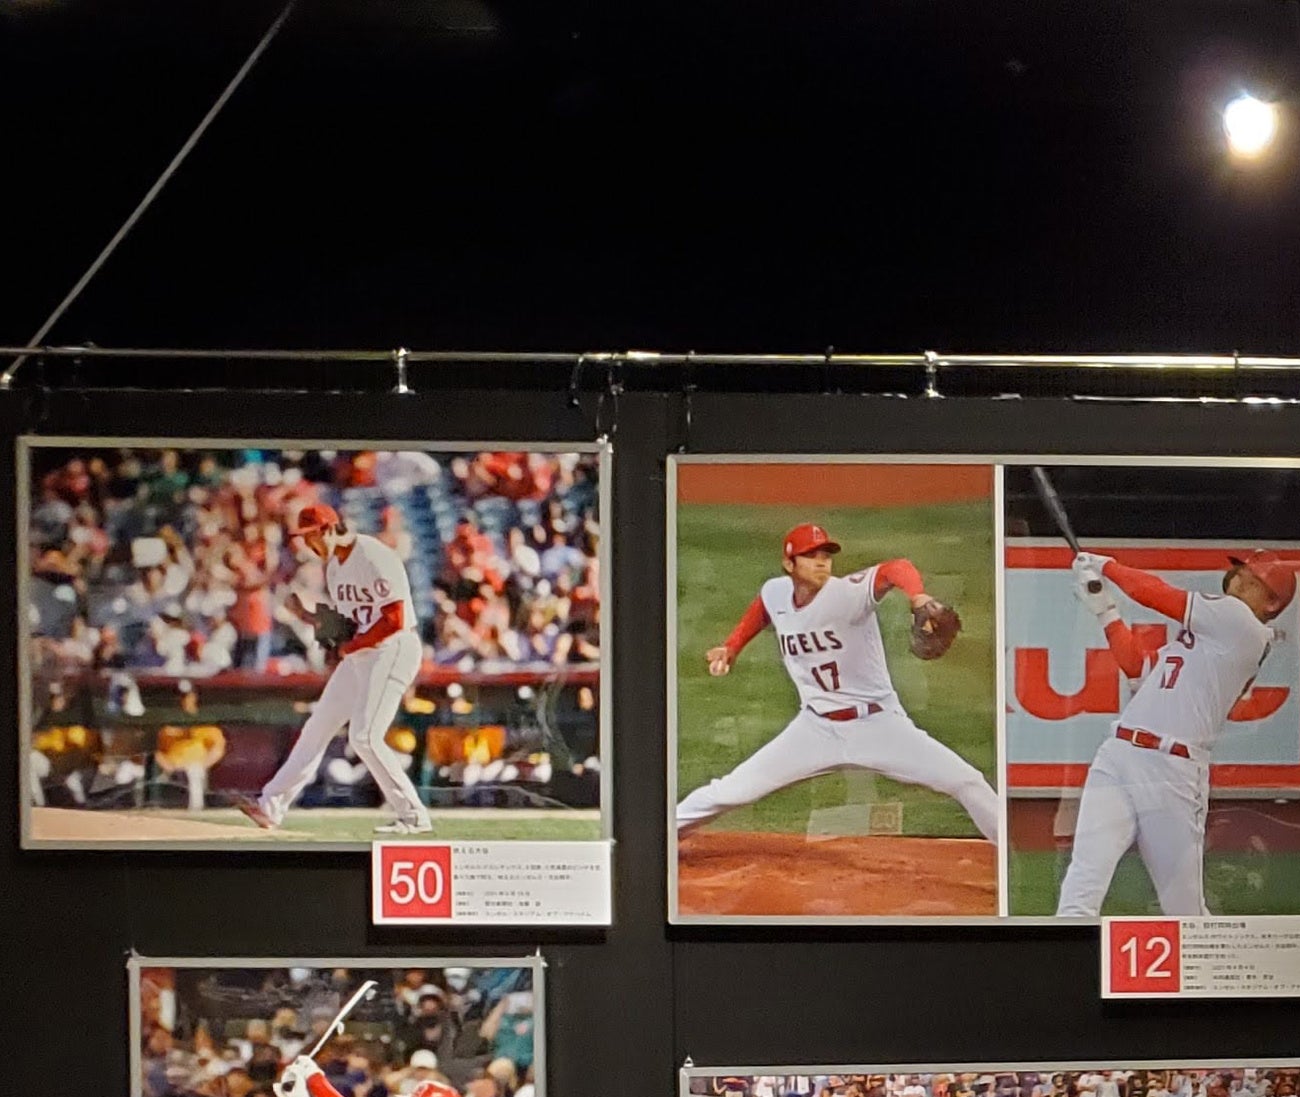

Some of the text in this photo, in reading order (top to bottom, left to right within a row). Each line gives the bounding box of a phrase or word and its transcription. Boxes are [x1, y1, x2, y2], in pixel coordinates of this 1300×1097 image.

[811, 661, 840, 692] 17
[389, 861, 443, 904] 50
[1120, 936, 1172, 978] 12
